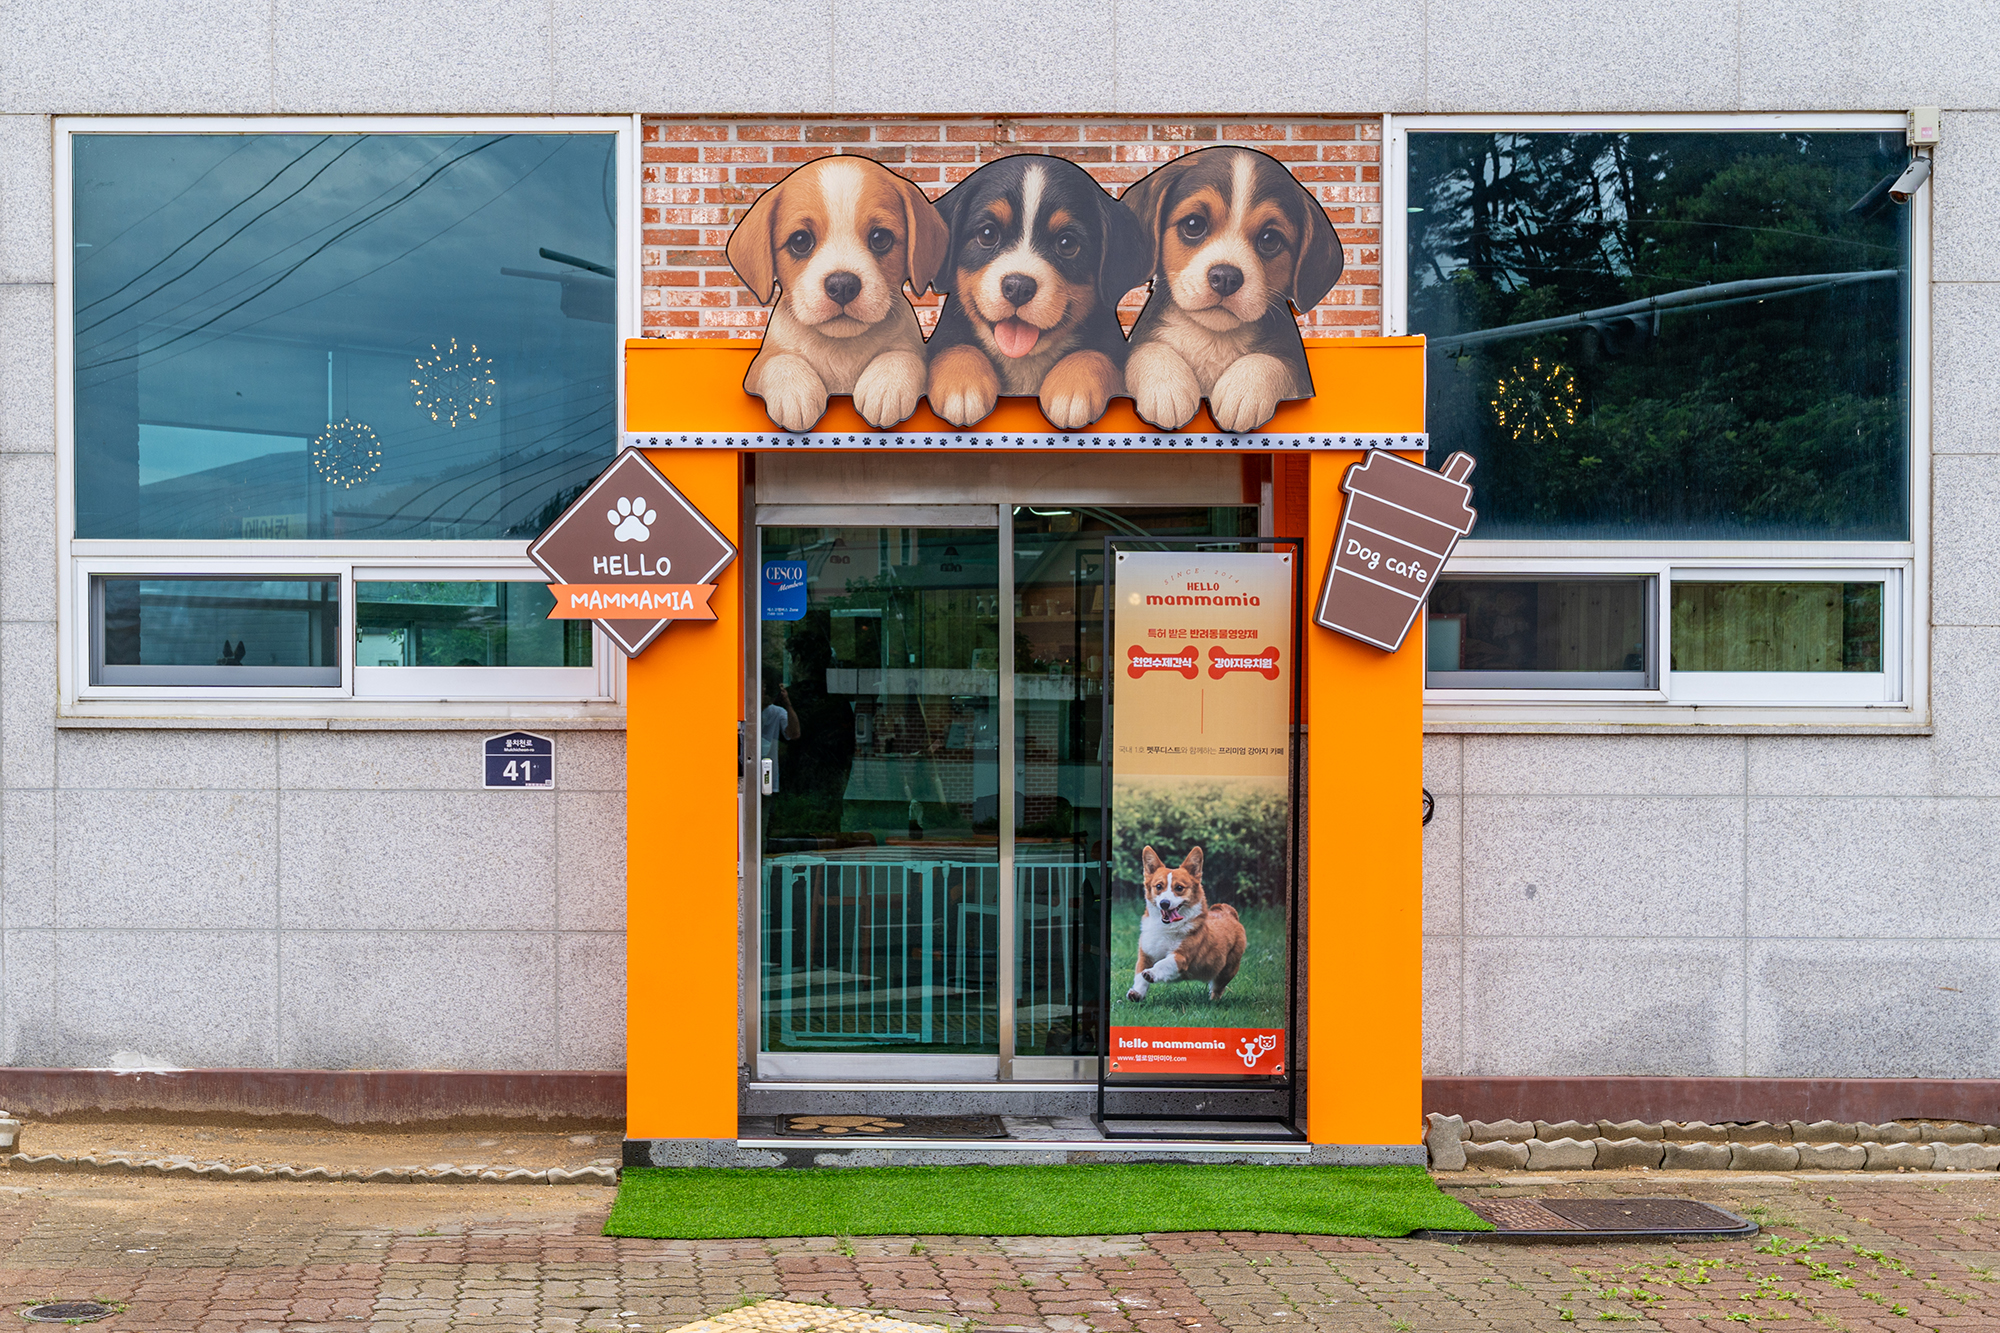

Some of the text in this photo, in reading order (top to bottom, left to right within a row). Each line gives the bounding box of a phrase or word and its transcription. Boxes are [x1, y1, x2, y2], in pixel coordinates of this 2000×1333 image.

[593, 553, 672, 577] HELLO
[1345, 538, 1428, 583] Dog cafe
[766, 566, 802, 580] CESCO
[1186, 582, 1220, 591] HELLO
[571, 590, 694, 611] MAMMAMIA
[1146, 592, 1260, 607] mammamia
[1147, 628, 1258, 640] 특허 받은 반려동물영양제
[1132, 656, 1192, 668] 천연수제간식
[1214, 657, 1273, 669] 강아지유치원
[1218, 747, 1246, 756] 프리미엄
[1247, 747, 1268, 756] 강아지
[1270, 747, 1284, 756] 카페
[503, 760, 531, 781] 41
[1118, 1037, 1226, 1050] hello mammamia
